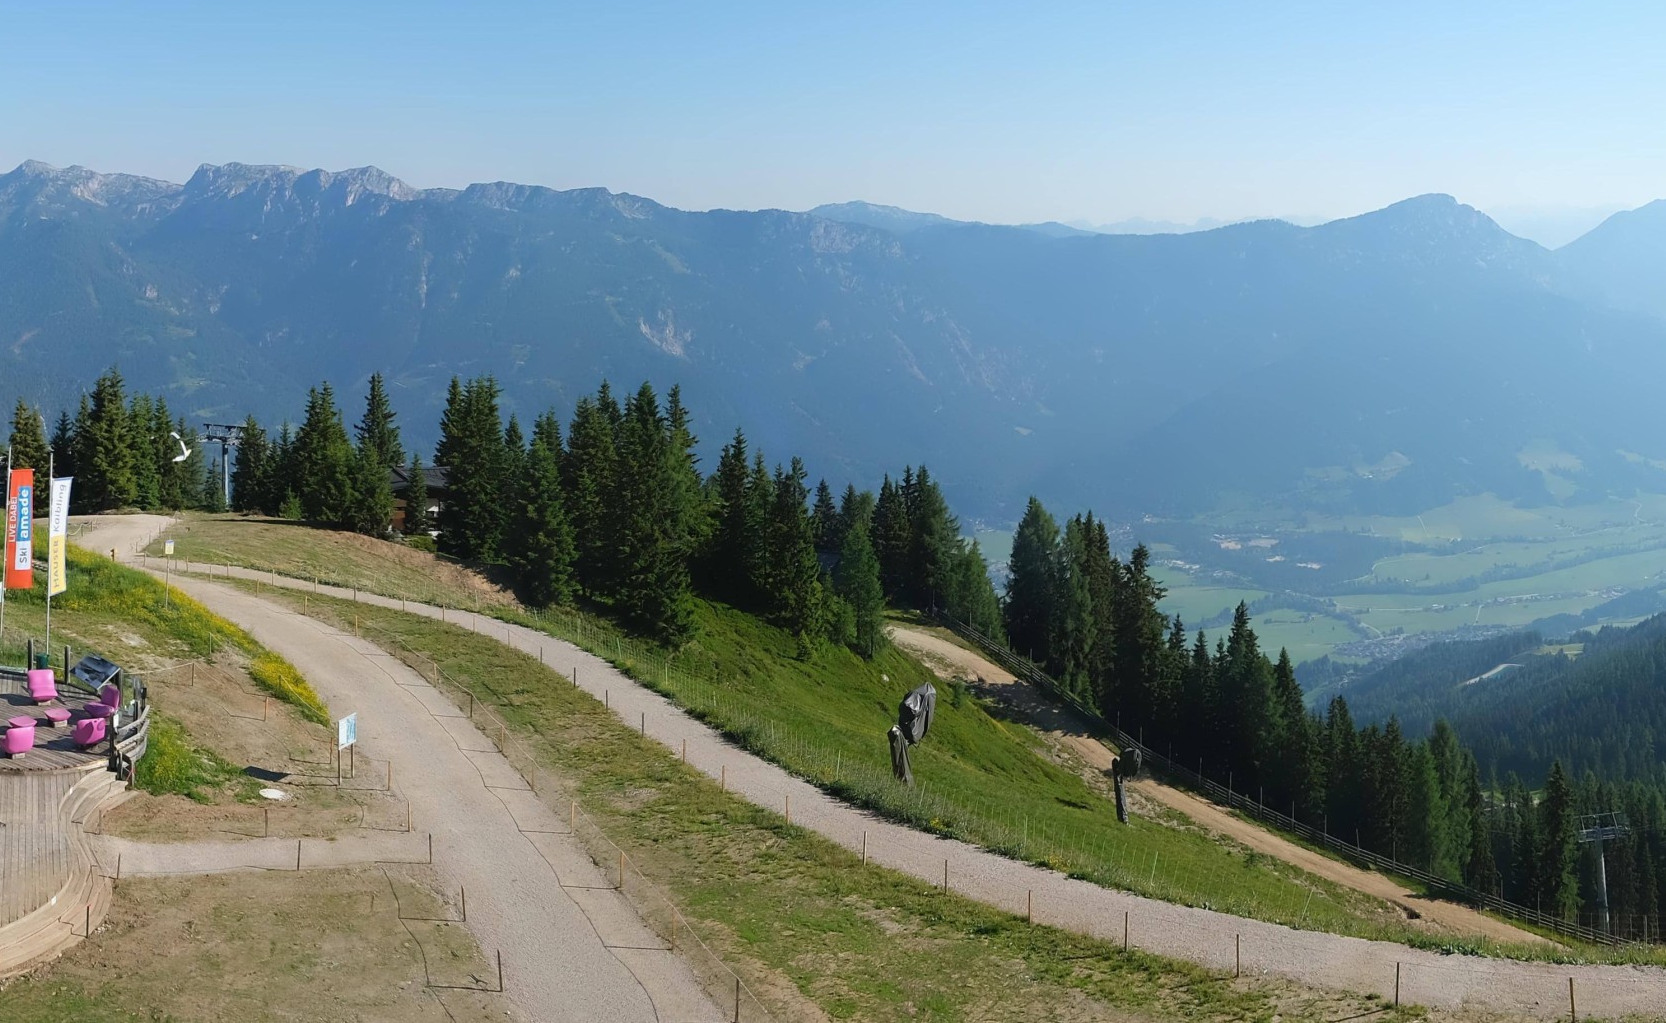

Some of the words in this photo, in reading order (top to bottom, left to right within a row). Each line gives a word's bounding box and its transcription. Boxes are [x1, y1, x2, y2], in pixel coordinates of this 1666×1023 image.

[9, 496, 18, 521] DABEI
[53, 484, 67, 532] Kaibling
[8, 523, 17, 543] LIVE
[19, 547, 28, 564] Ski
